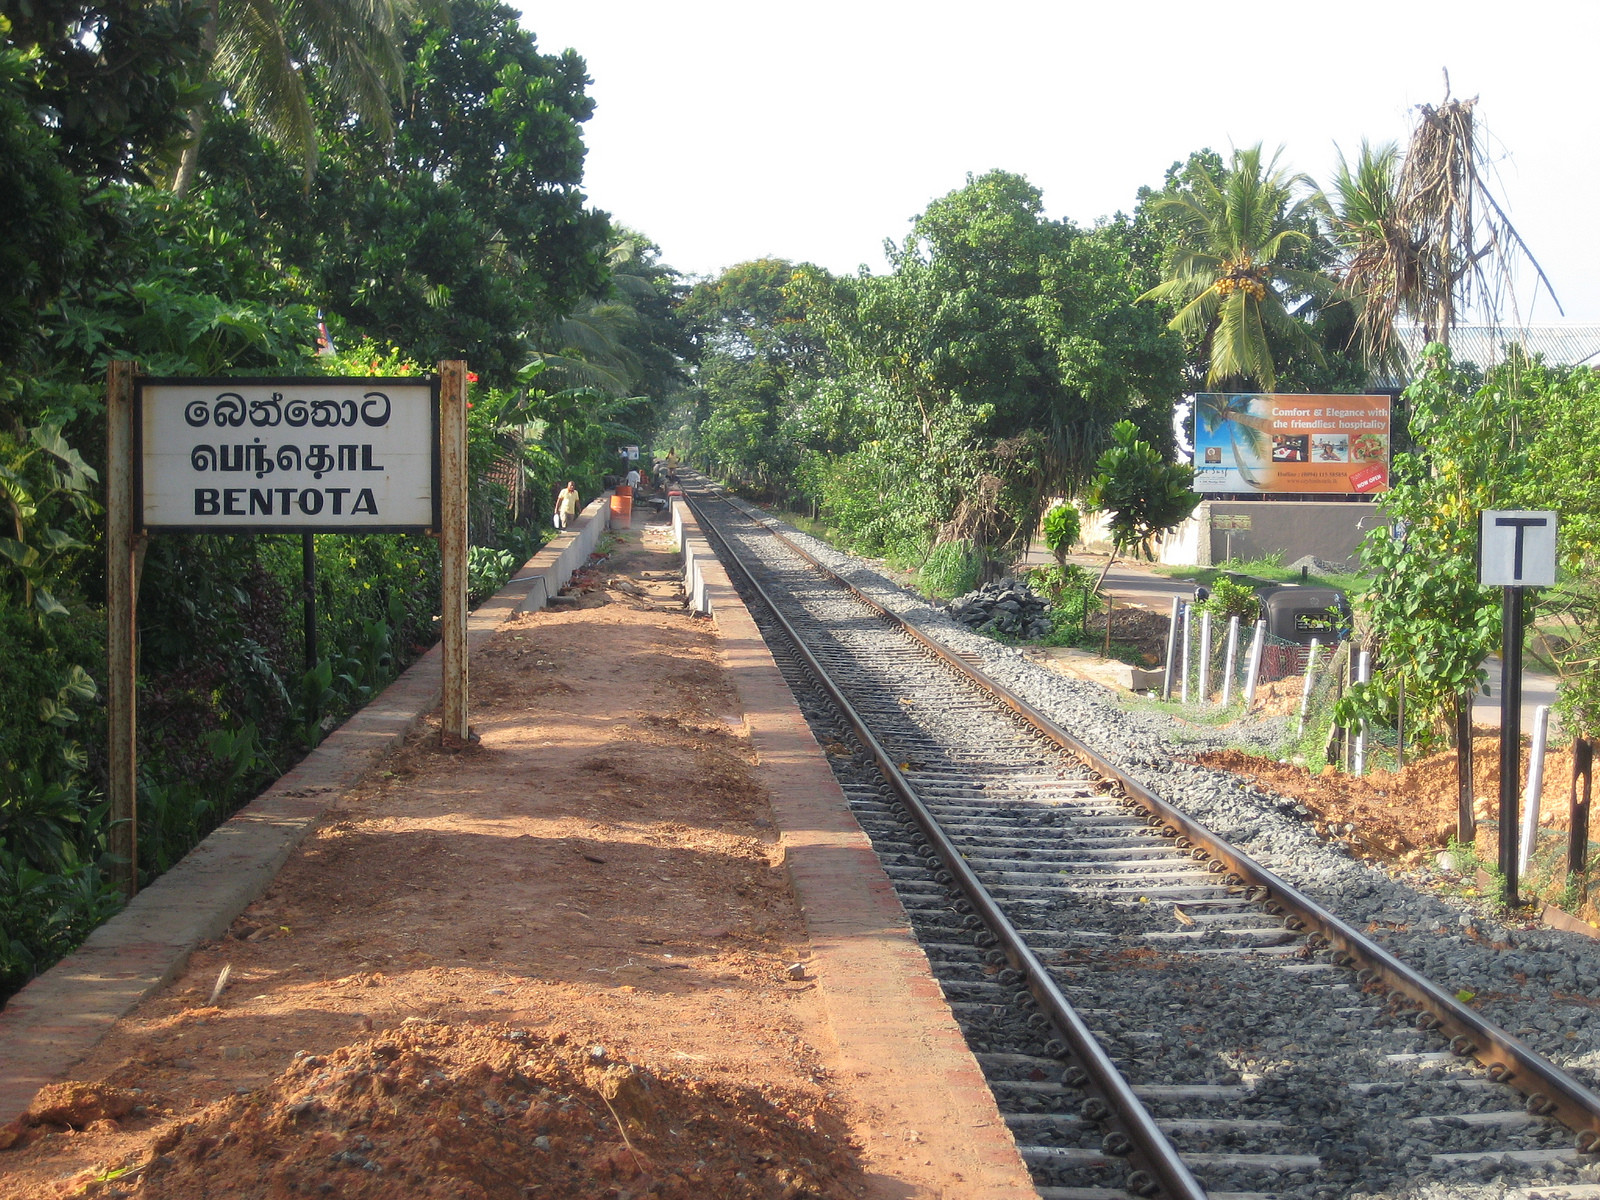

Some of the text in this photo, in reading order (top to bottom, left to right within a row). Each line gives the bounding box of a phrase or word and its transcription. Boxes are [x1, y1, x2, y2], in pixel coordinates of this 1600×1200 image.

[184, 391, 392, 428] බෙන්තොට
[1272, 408, 1388, 418] Comfort & Elegance with
[1273, 420, 1386, 430] the friendliest hospitality
[191, 437, 385, 480] பெந்தொட
[1356, 474, 1382, 489] NOW OPEN
[194, 488, 379, 516] BENTOTA
[1495, 517, 1547, 581] T
